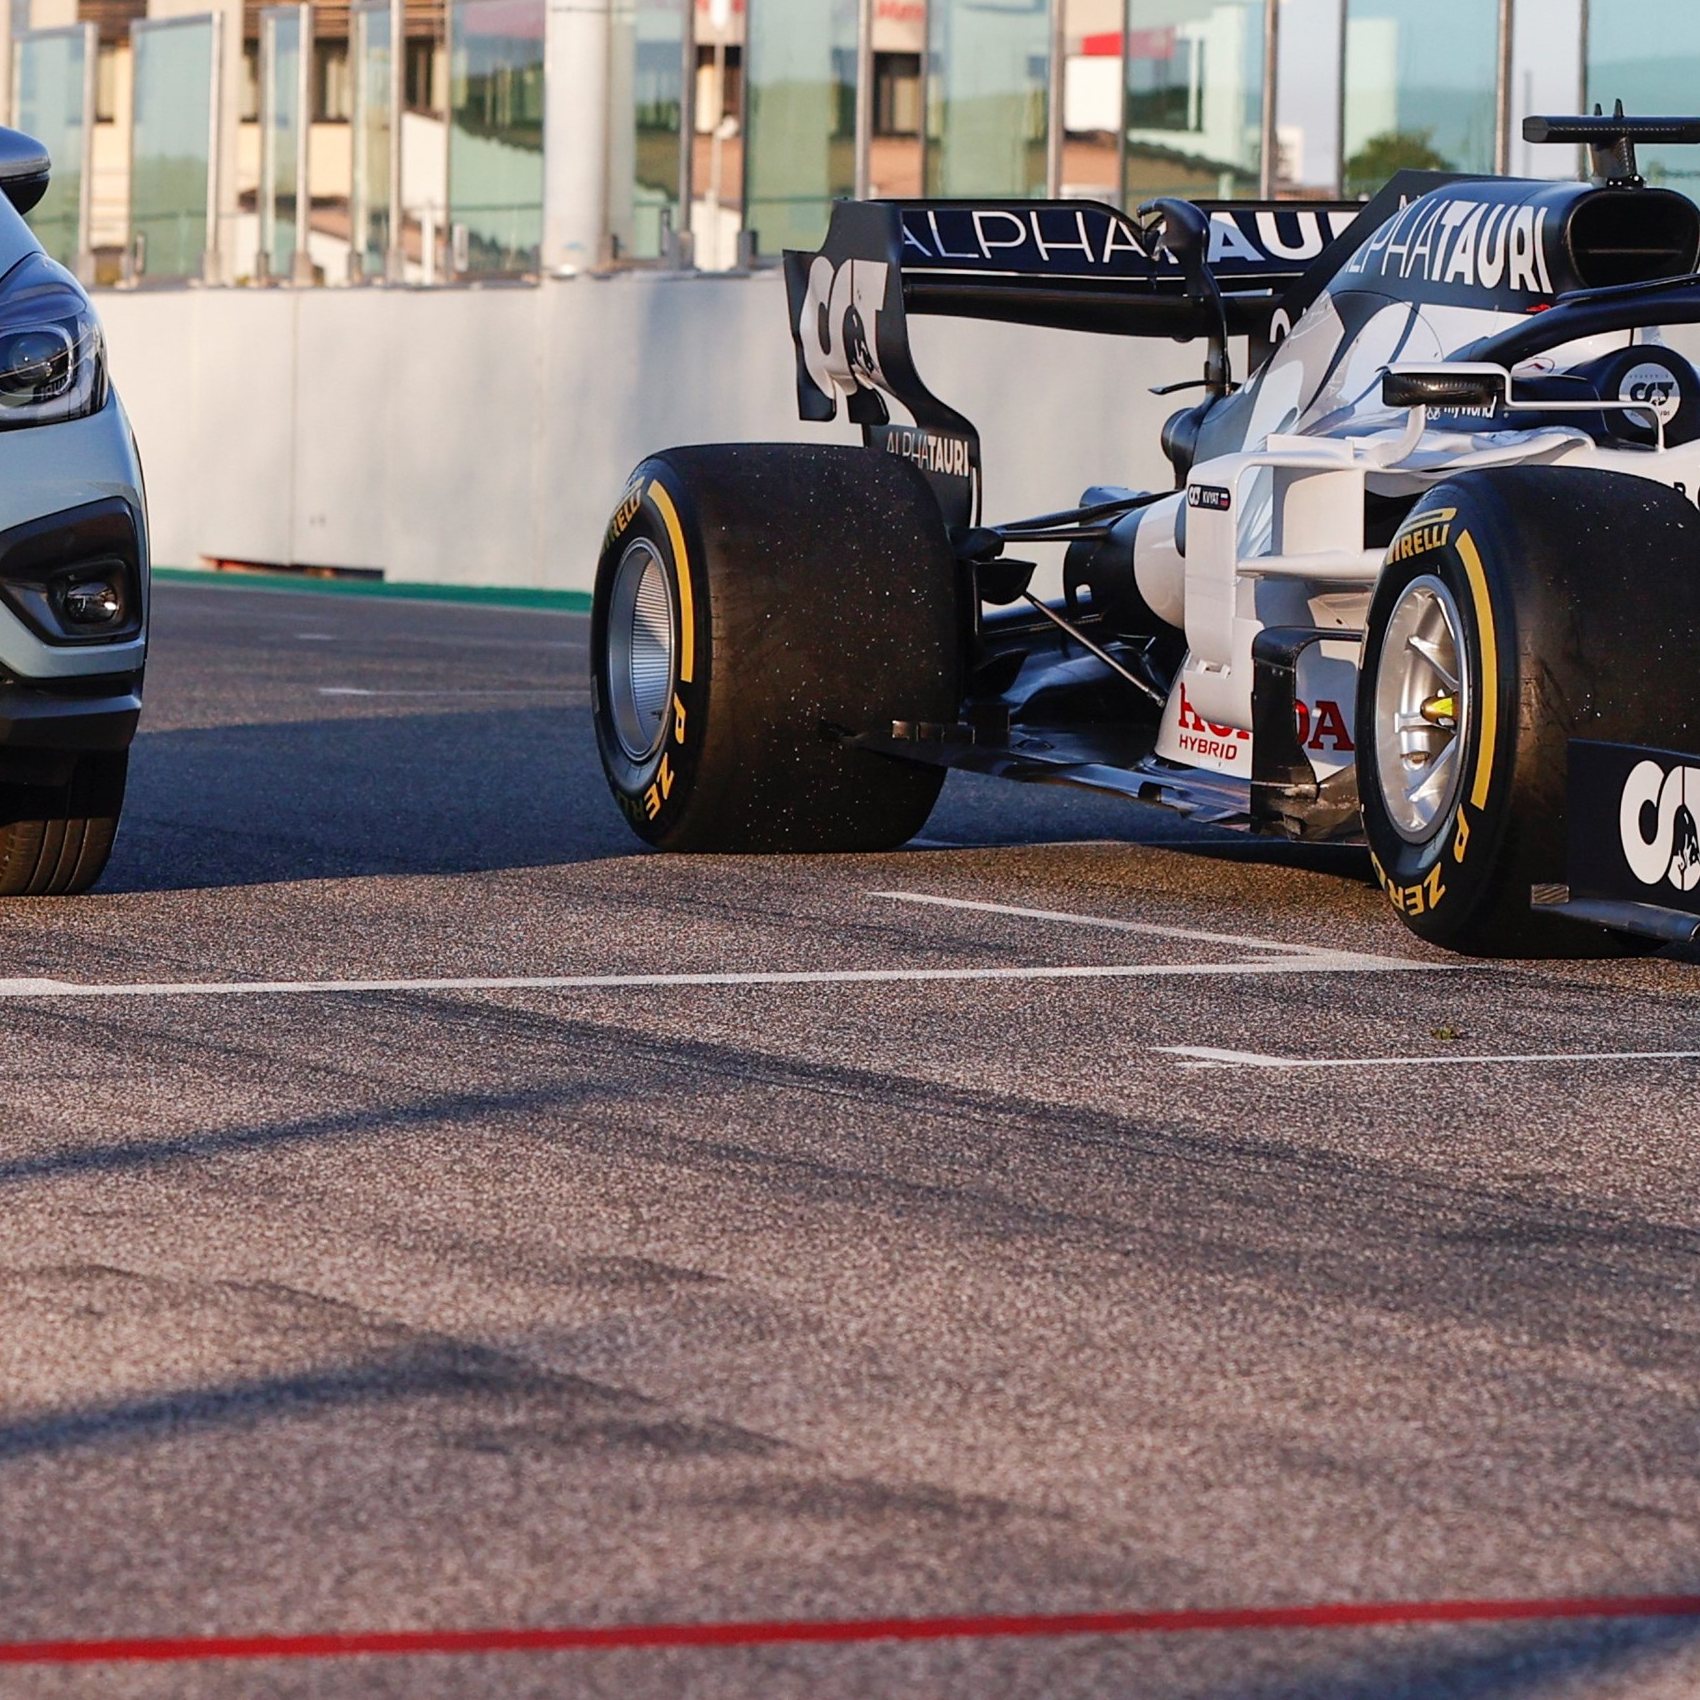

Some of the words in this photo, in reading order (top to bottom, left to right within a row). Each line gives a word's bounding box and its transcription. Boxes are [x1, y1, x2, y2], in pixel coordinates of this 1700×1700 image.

[1387, 507, 1457, 565] PIRELLI
[1179, 734, 1238, 760] HYBRID
[1370, 851, 1446, 916] ZERO
